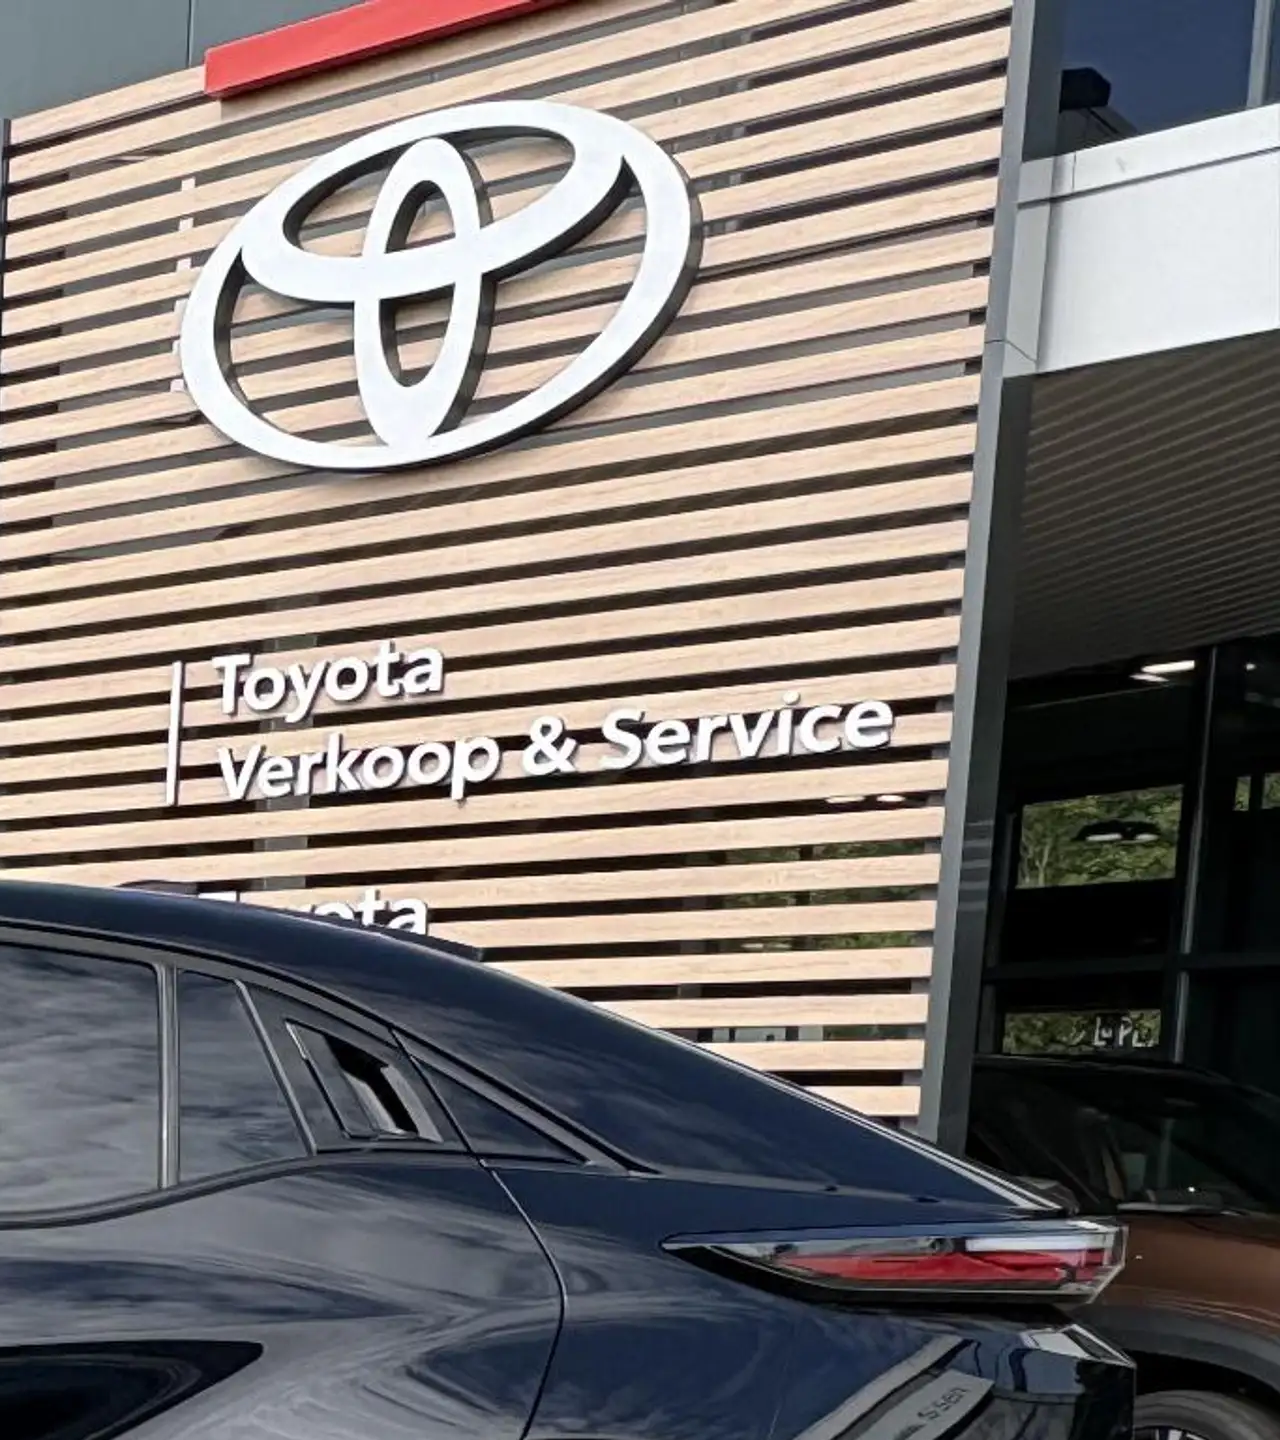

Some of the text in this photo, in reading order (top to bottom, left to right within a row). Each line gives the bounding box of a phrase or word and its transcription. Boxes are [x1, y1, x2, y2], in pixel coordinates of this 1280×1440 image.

[211, 640, 445, 722] Toyota
[218, 690, 896, 802] Verkoop & Service
